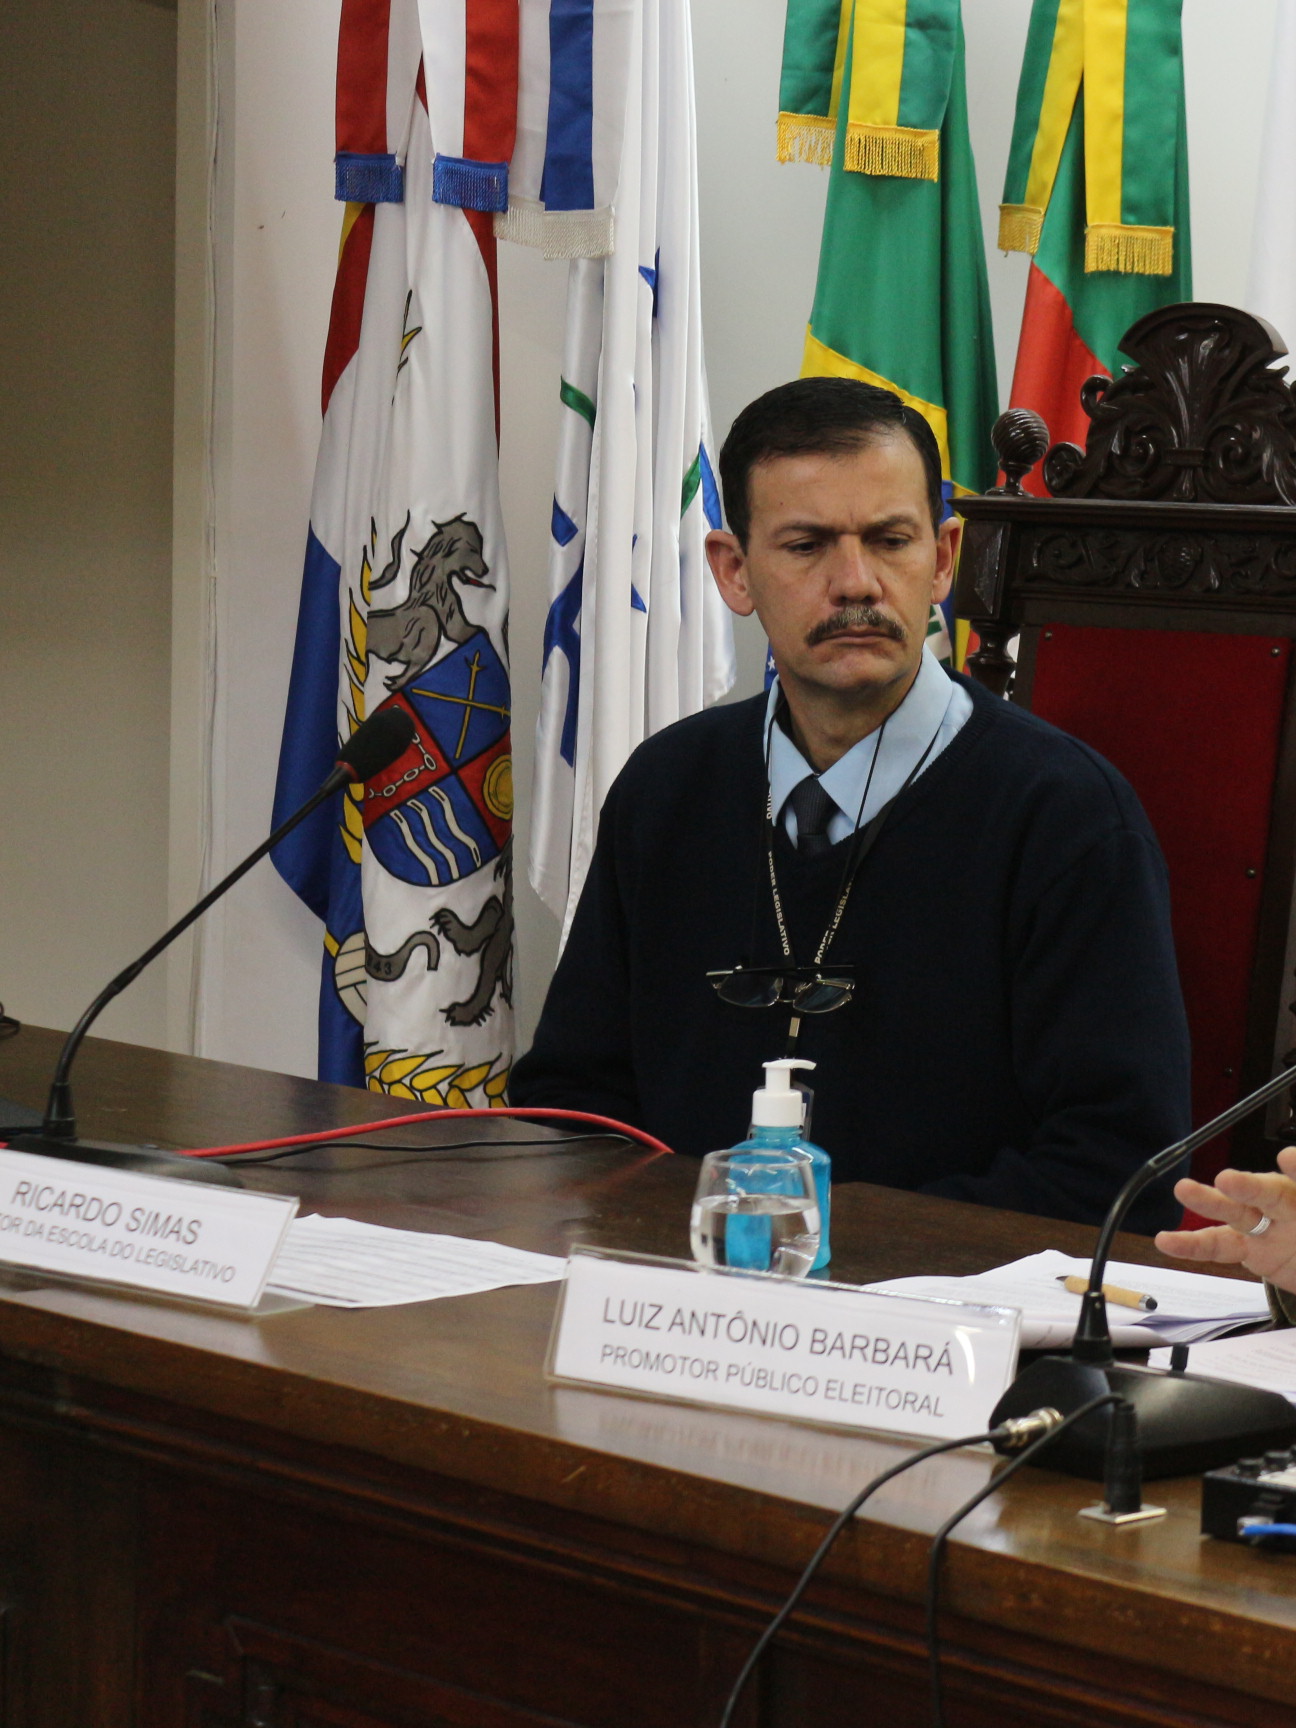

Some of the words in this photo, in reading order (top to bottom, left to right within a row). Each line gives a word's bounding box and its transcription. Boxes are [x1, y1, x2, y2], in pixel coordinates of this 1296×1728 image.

[773, 888, 790, 956] LEGISLATIVO
[10, 1181, 123, 1227] RICARDO
[125, 1207, 202, 1245] SIMAS
[23, 1220, 45, 1239] DA
[46, 1225, 107, 1254] ESCOLA
[108, 1240, 136, 1260] DO
[134, 1248, 237, 1283] LEGISLATIVO
[602, 1297, 664, 1331] LUIZ
[667, 1308, 800, 1351] ANTÔNIO
[809, 1327, 954, 1376] BARBARÁ
[600, 1343, 720, 1381] PROMOTOR
[725, 1361, 820, 1397] PÚBLICO
[823, 1378, 945, 1417] ELEITORAL
